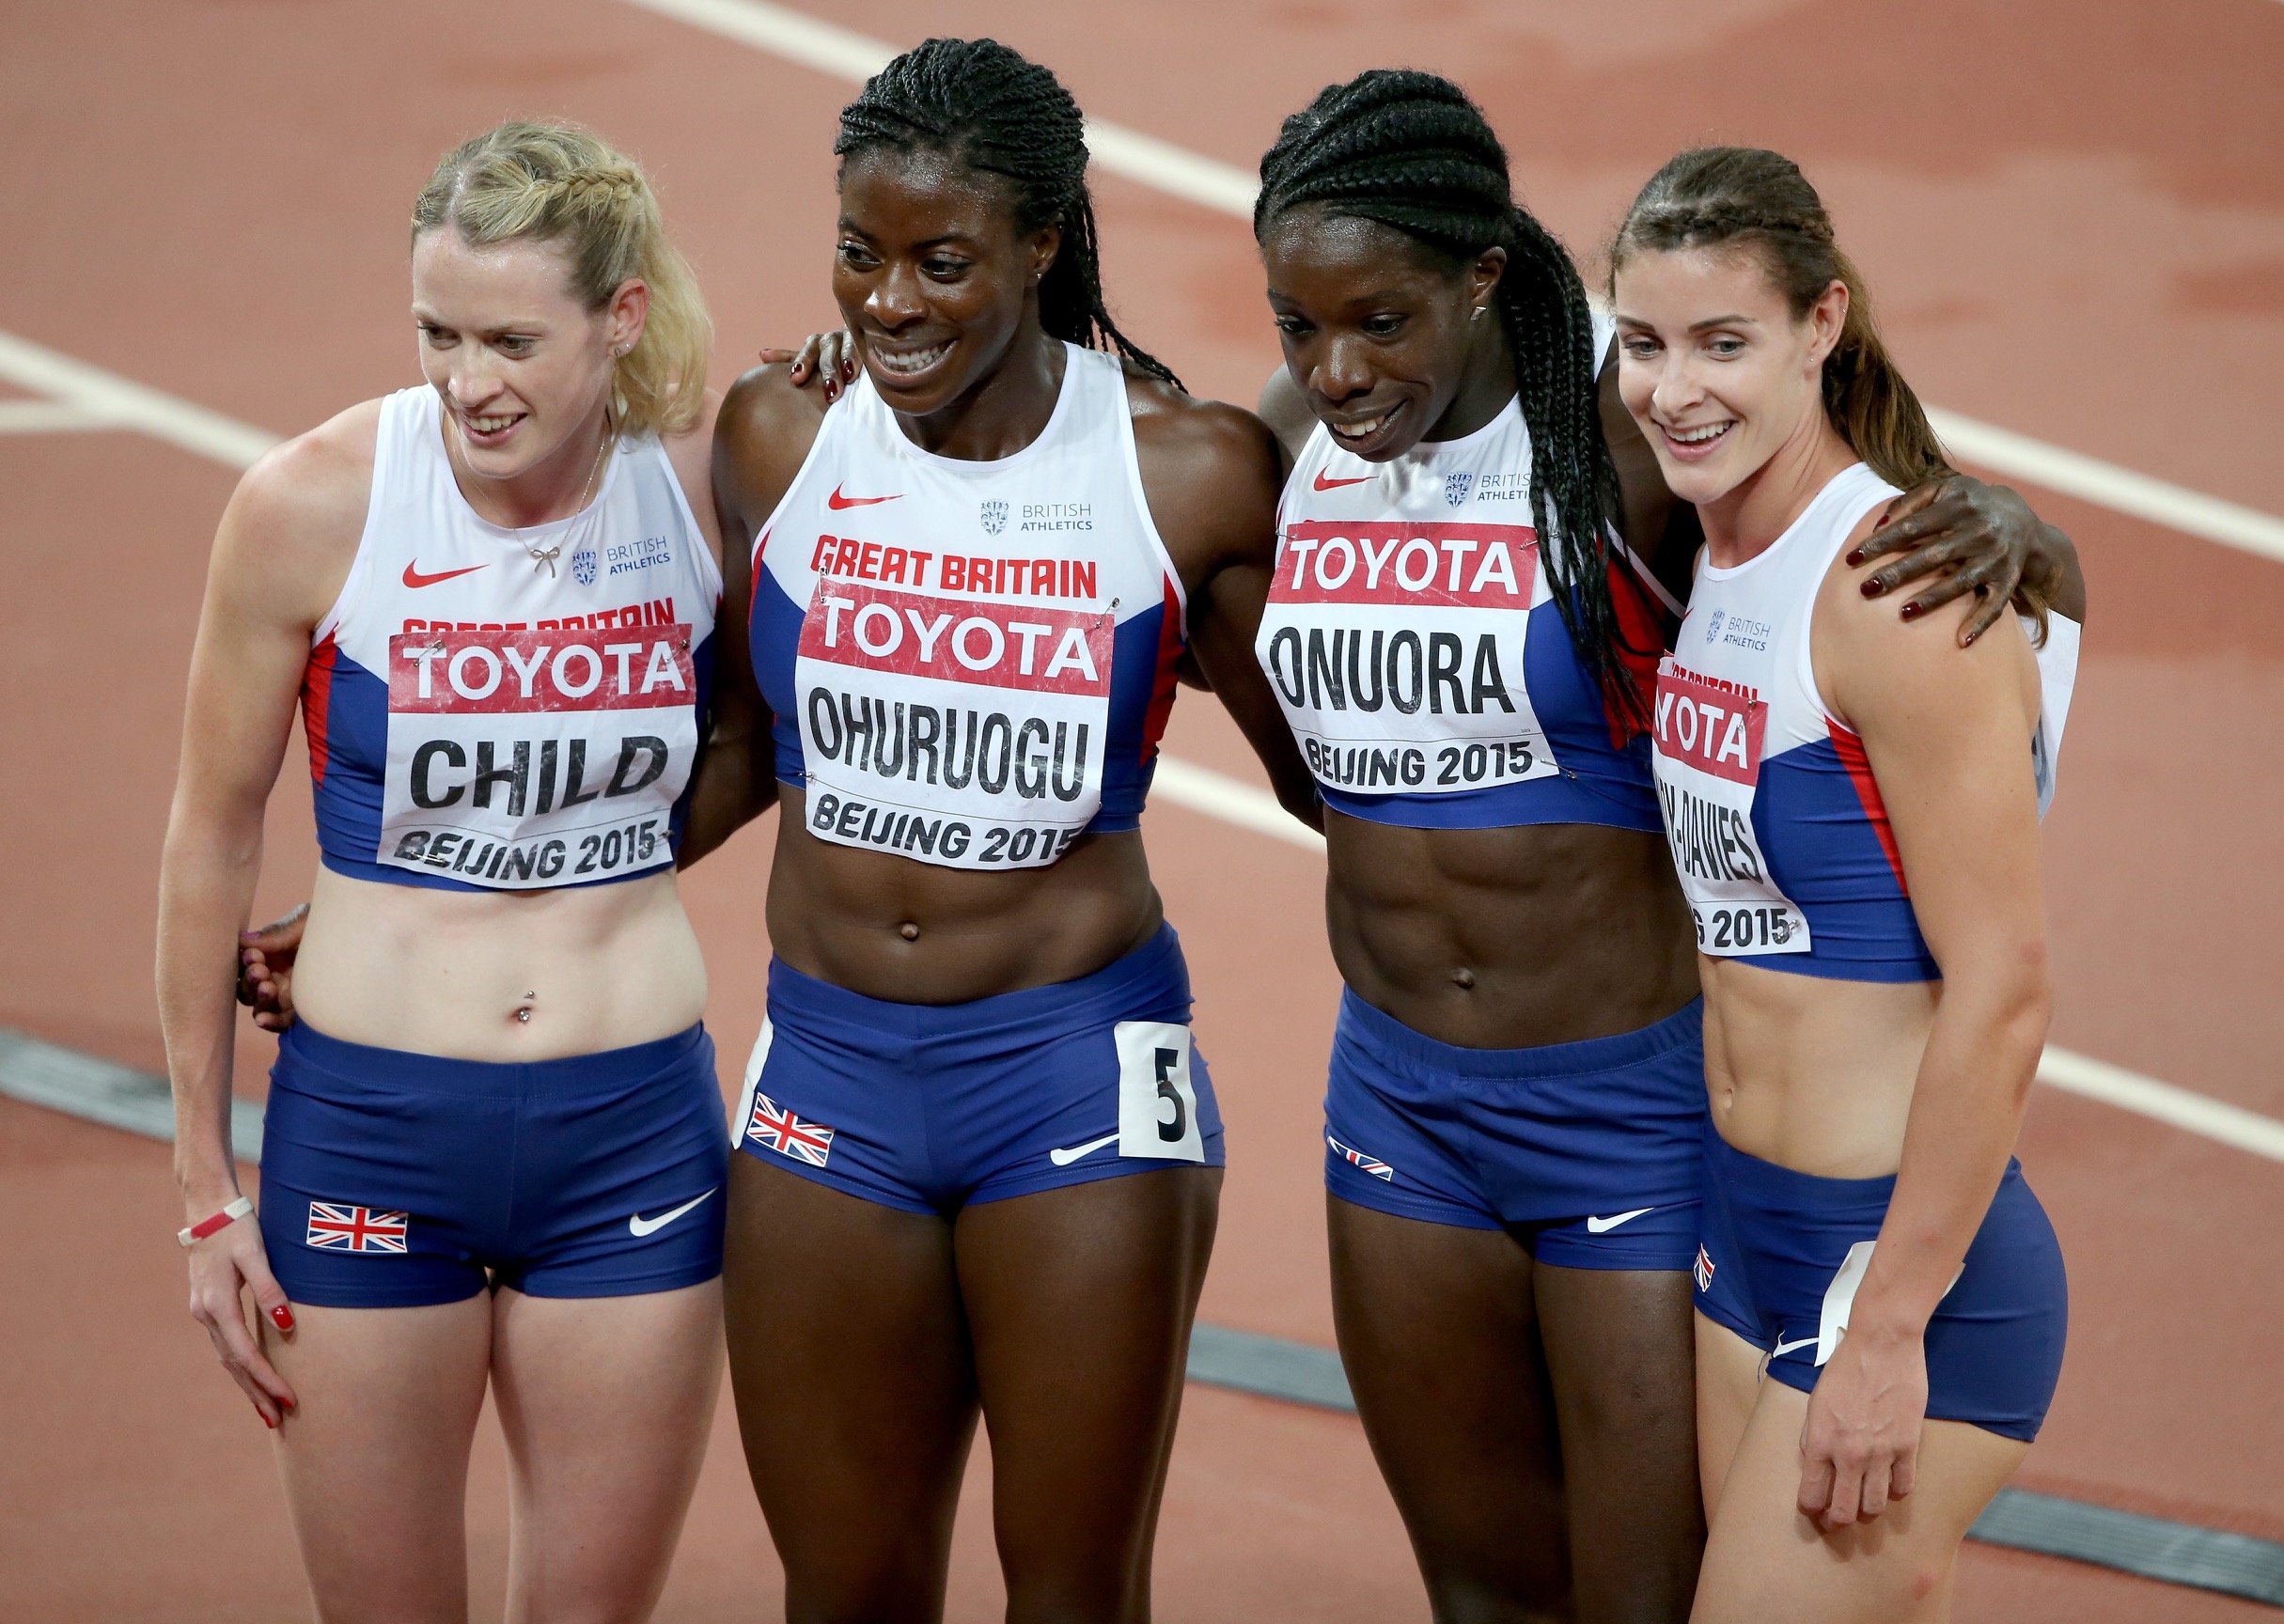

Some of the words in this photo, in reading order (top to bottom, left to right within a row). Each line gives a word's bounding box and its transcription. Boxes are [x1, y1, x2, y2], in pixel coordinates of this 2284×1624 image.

[1477, 490, 1528, 502] ATHLETI
[1481, 473, 1531, 488] BRITIS
[1020, 520, 1093, 532] ATHLETICS
[1023, 503, 1092, 519] BRITISH
[606, 536, 667, 562] BRITISH
[609, 552, 671, 575] ATHLETICS
[810, 534, 932, 586] GREAT
[940, 554, 1098, 599] BRITAIN
[1289, 537, 1520, 595] TOYOTA
[823, 596, 1100, 682] TOYOTA
[1723, 633, 1767, 651] ATHLETICS
[1728, 617, 1772, 638] BRITISH
[402, 641, 686, 700] TOYOTA
[1269, 627, 1517, 715] ONUORA
[808, 687, 1089, 803] OHURUOGU
[1655, 685, 1748, 770] YOTA
[410, 735, 669, 817] CHILD
[1305, 738, 1426, 787] BEIJING
[1436, 741, 1533, 786] 2015
[393, 830, 565, 881] BEIJING
[574, 820, 658, 875] 2015
[813, 793, 971, 858] BEIJING
[978, 825, 1085, 863] 2015
[1658, 776, 1764, 884] Y-DAVIES
[1712, 908, 1791, 947] 2015
[1154, 1047, 1186, 1143] 5
